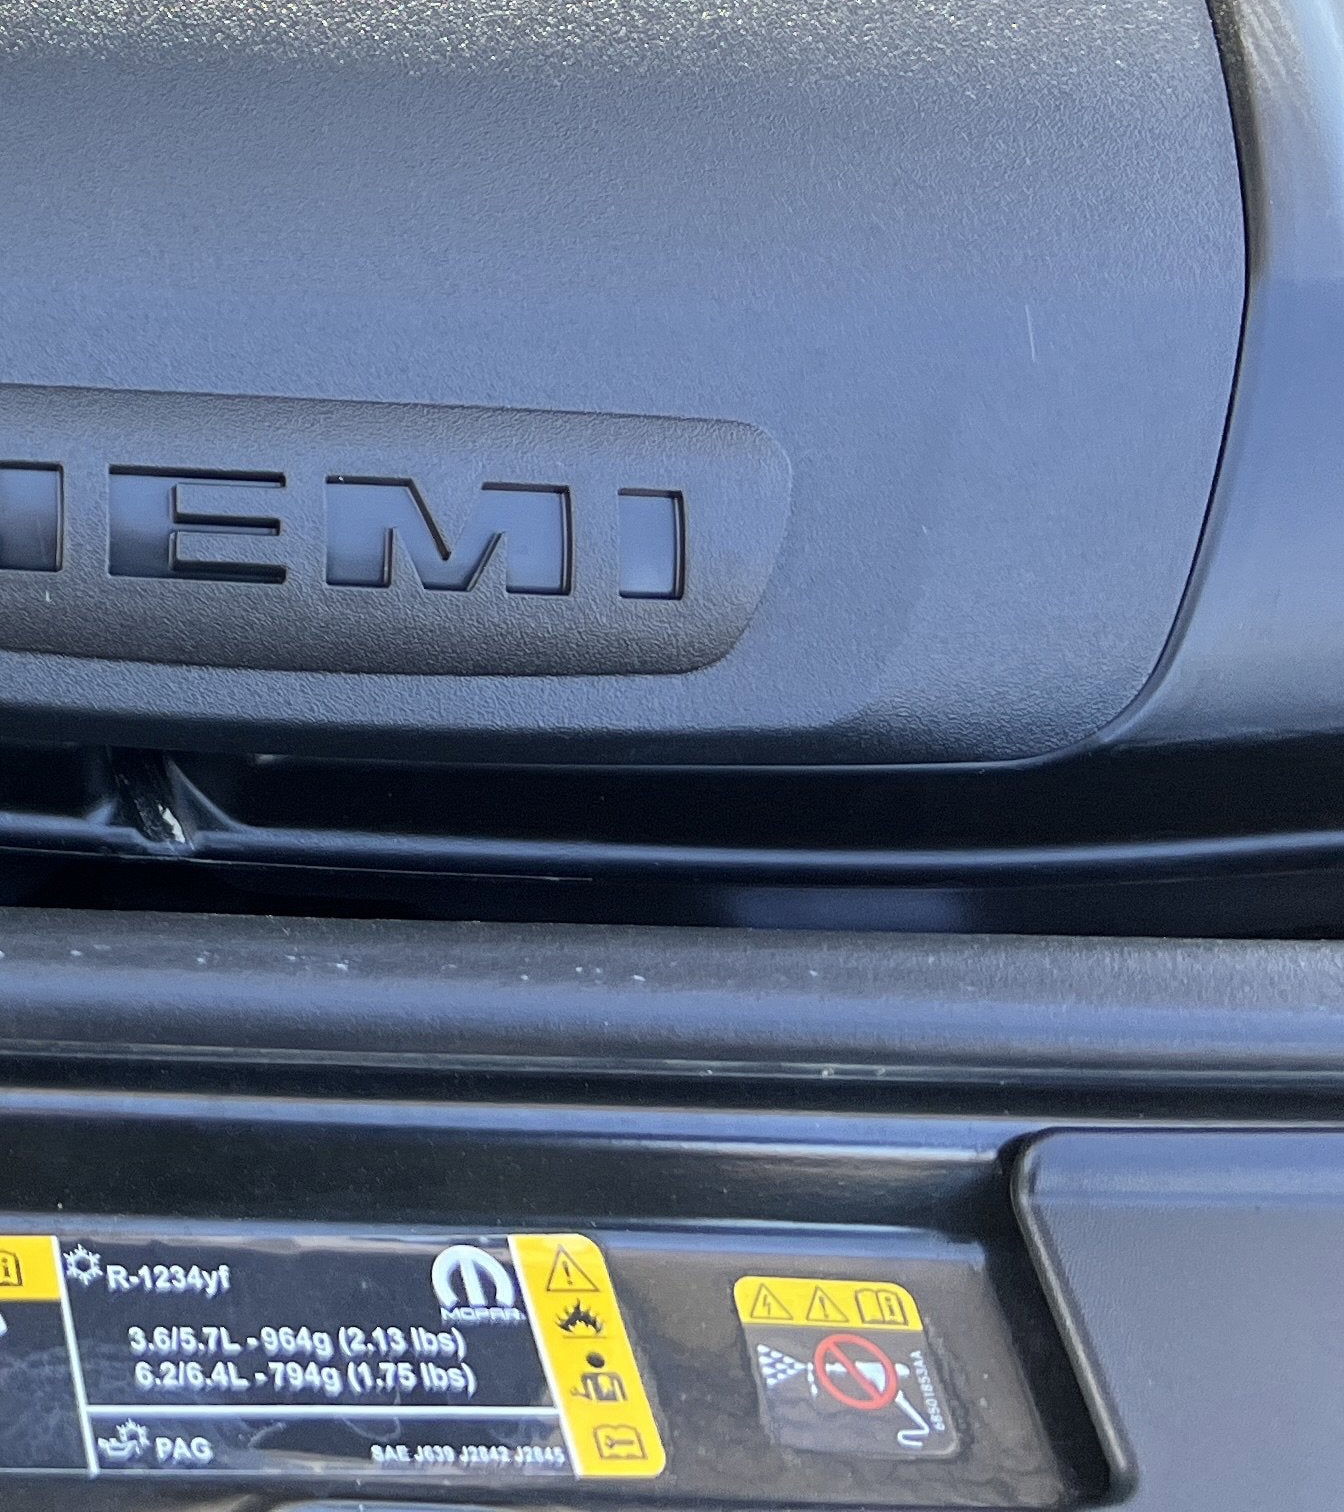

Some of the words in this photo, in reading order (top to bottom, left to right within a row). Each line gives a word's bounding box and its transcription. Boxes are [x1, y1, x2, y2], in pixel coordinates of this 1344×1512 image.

[106, 1263, 231, 1298] R-1234yf
[440, 1306, 520, 1324] MOPAR
[127, 1325, 243, 1355] 3.6/5.7L
[260, 1325, 333, 1361] 964g
[337, 1325, 409, 1357] (2.13
[410, 1325, 468, 1361] lbs)
[134, 1360, 250, 1390] 6.2/6.4L
[267, 1360, 344, 1397] 794g
[347, 1361, 417, 1393] (1.75
[419, 1361, 478, 1400] lbs)
[154, 1436, 214, 1464] PAG
[370, 1444, 411, 1463] SAE
[414, 1444, 456, 1463] J639
